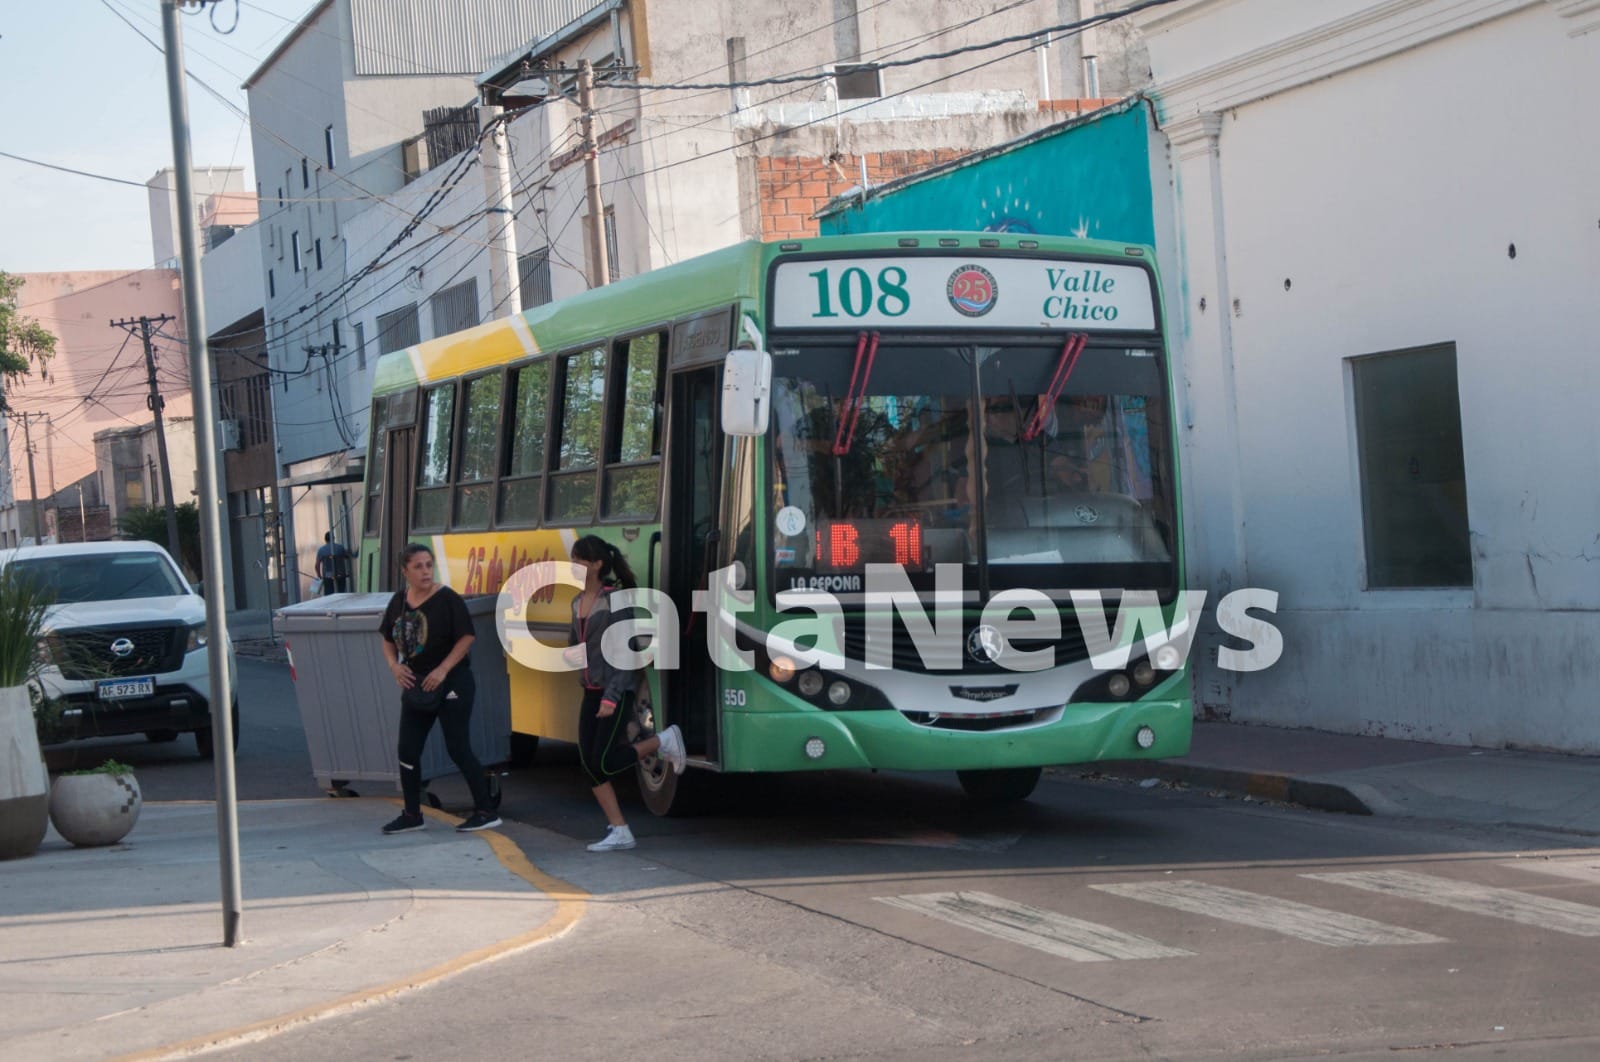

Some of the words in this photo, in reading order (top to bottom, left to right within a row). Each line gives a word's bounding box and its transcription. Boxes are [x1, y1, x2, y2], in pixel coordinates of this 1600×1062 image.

[809, 266, 911, 318] 108
[958, 279, 988, 302] 25
[1045, 268, 1115, 294] Valle
[1042, 296, 1119, 321] Chico
[464, 547, 485, 594] 25
[487, 545, 503, 594] de
[790, 577, 806, 592] LA
[809, 575, 861, 592] PEPONA
[102, 687, 113, 697] AF
[117, 684, 136, 695] 573
[138, 683, 151, 693] RX
[724, 688, 747, 707] 550
